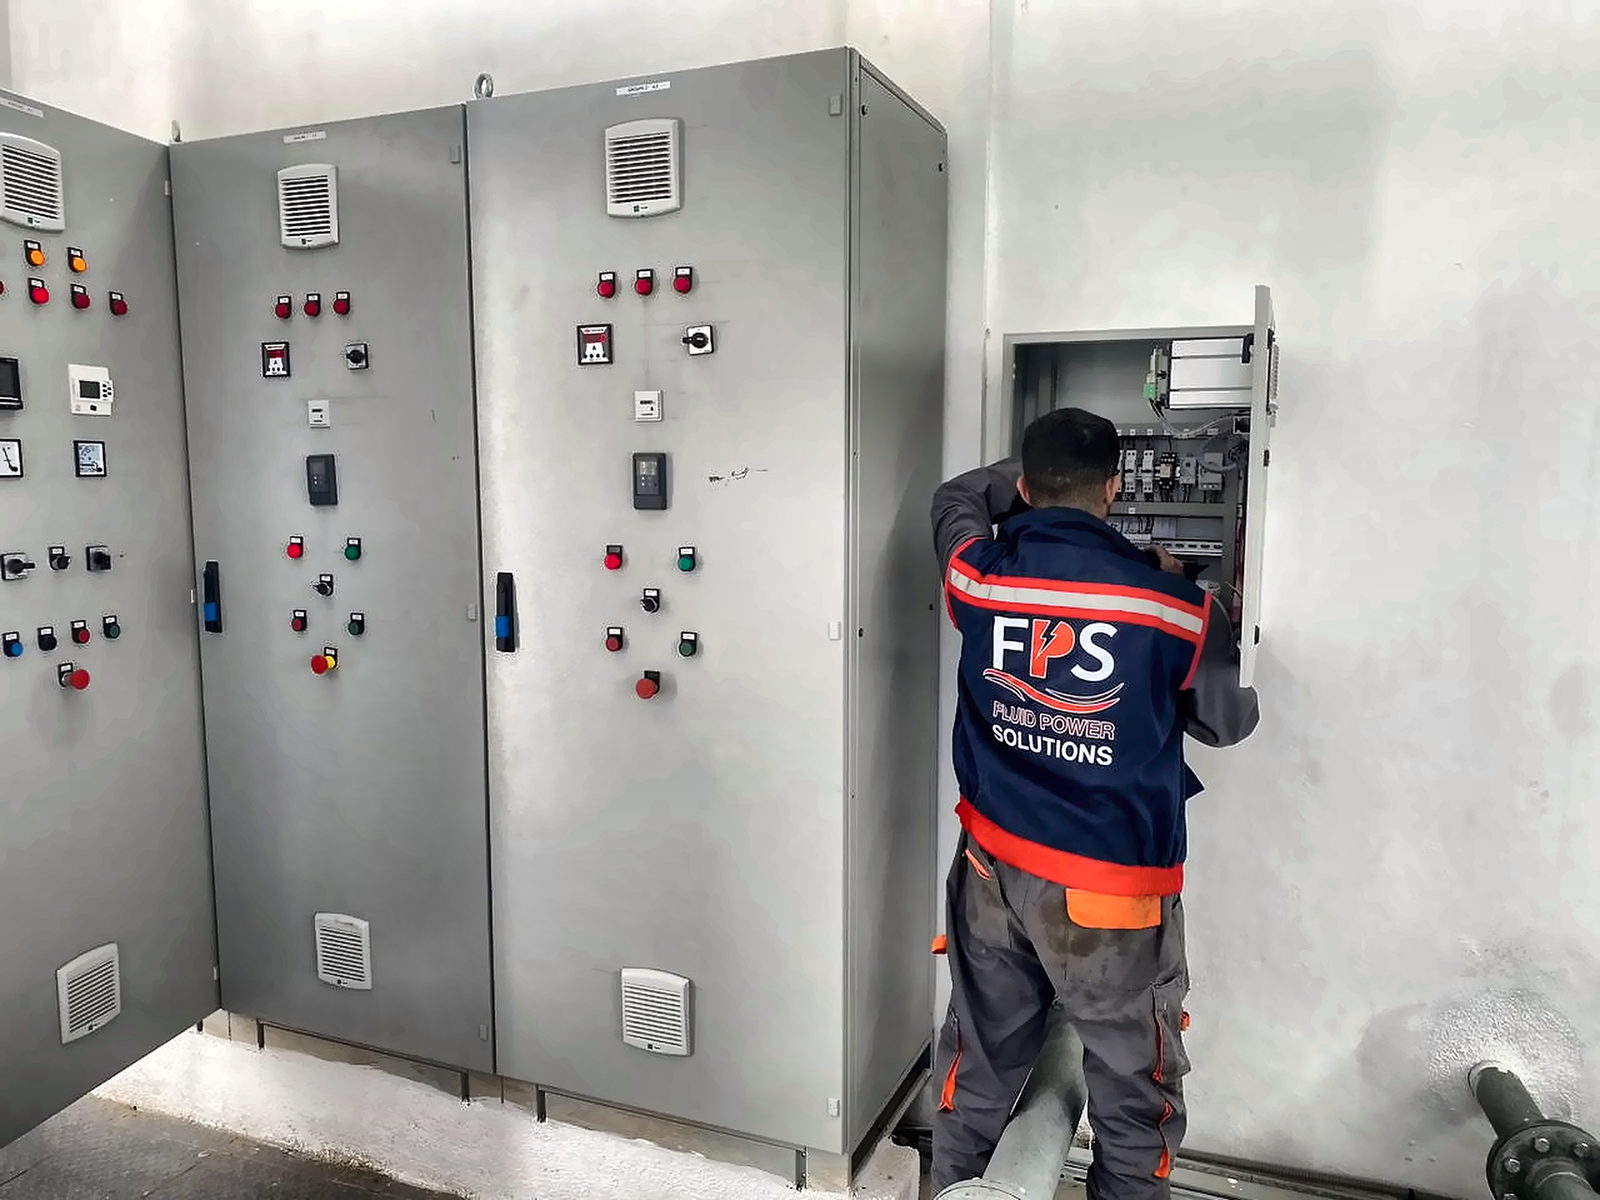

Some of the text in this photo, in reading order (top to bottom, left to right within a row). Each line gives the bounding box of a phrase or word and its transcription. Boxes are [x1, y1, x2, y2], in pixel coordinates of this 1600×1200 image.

[993, 615, 1118, 682] FPS
[993, 700, 1116, 741] FLUID POWER
[992, 724, 1113, 766] SOLUTIONS
